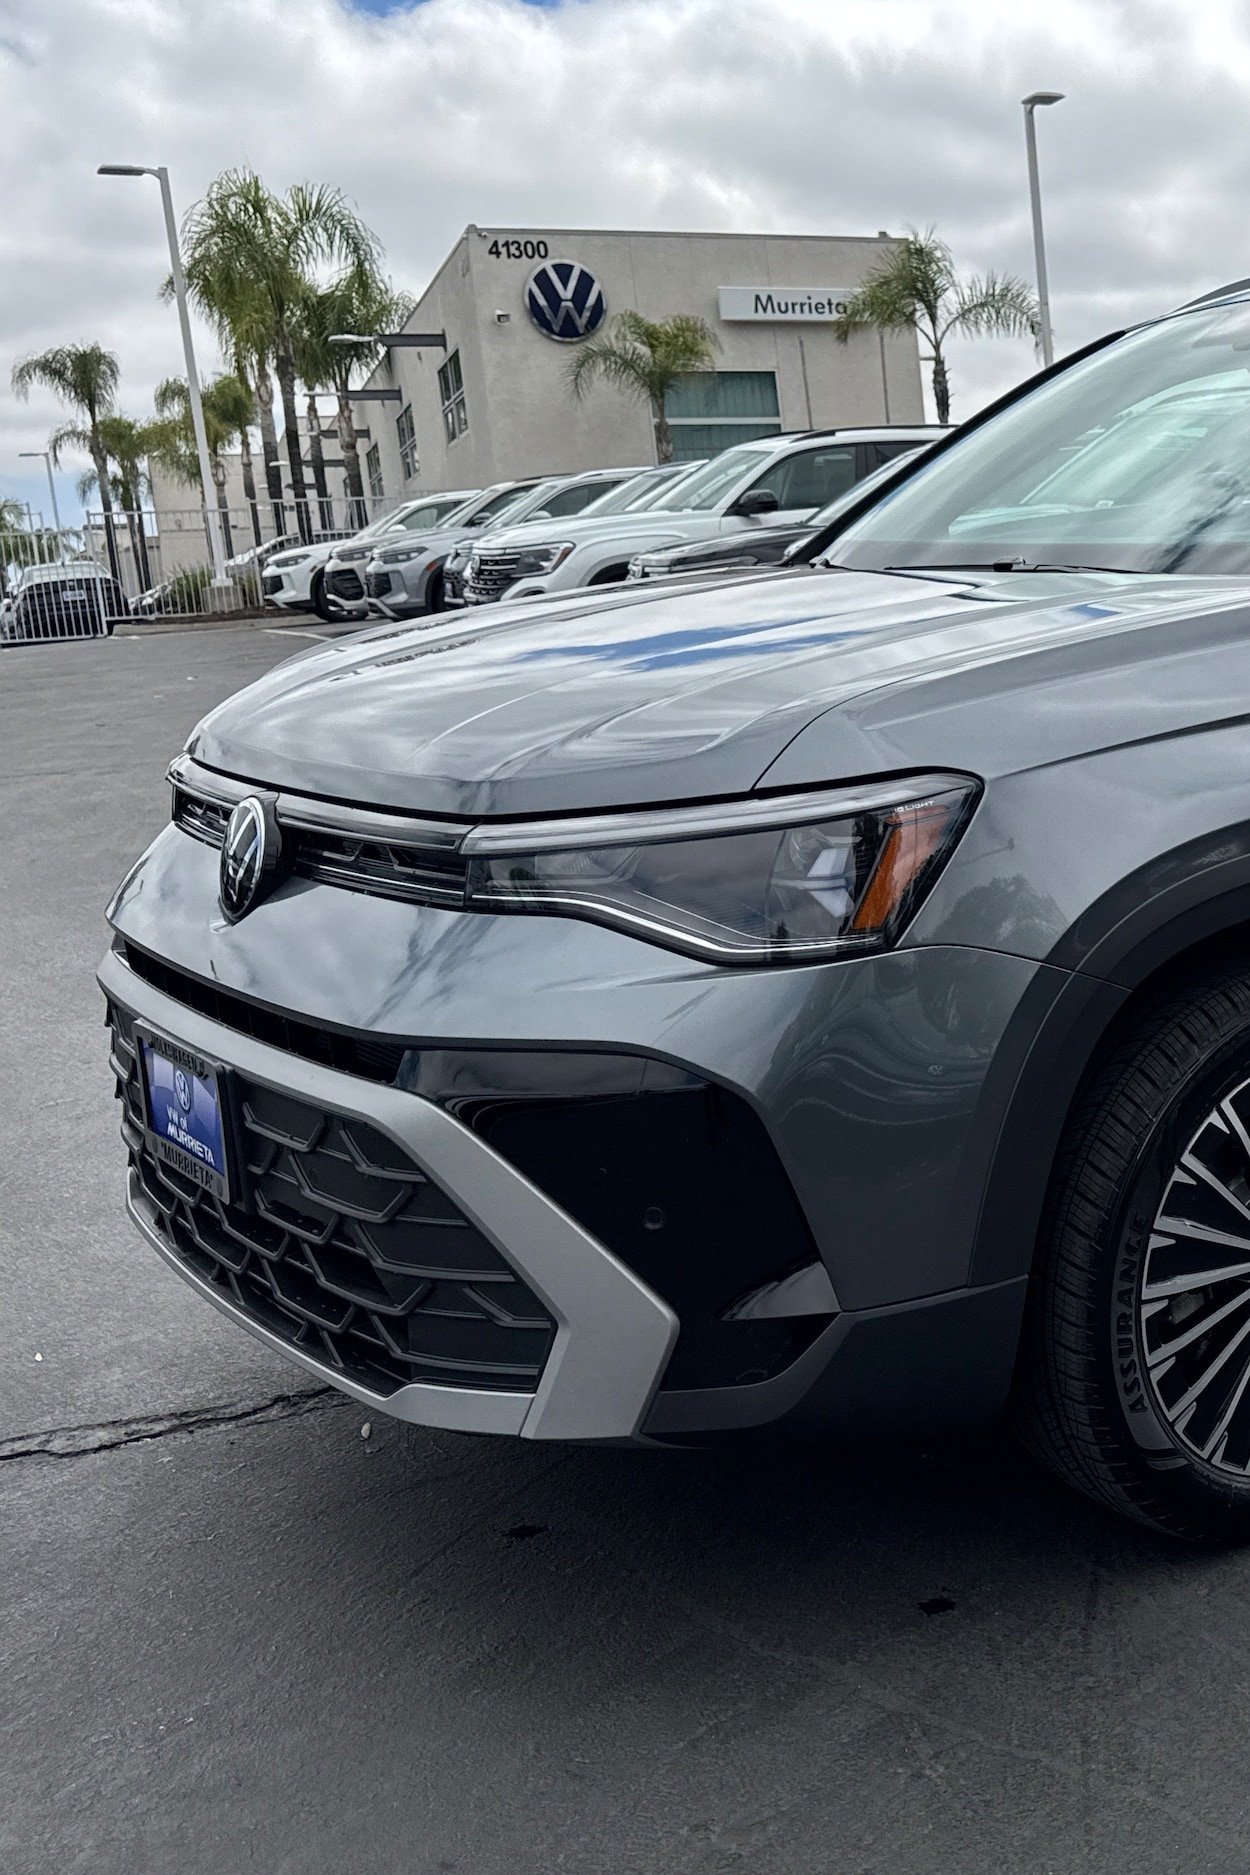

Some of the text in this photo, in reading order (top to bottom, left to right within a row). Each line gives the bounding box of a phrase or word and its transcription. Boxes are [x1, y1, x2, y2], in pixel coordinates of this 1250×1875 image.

[488, 240, 549, 260] 41300
[754, 294, 848, 315] Murrieta
[167, 1122, 215, 1167] MURRIETA
[1117, 1211, 1148, 1413] ASSURANCE
